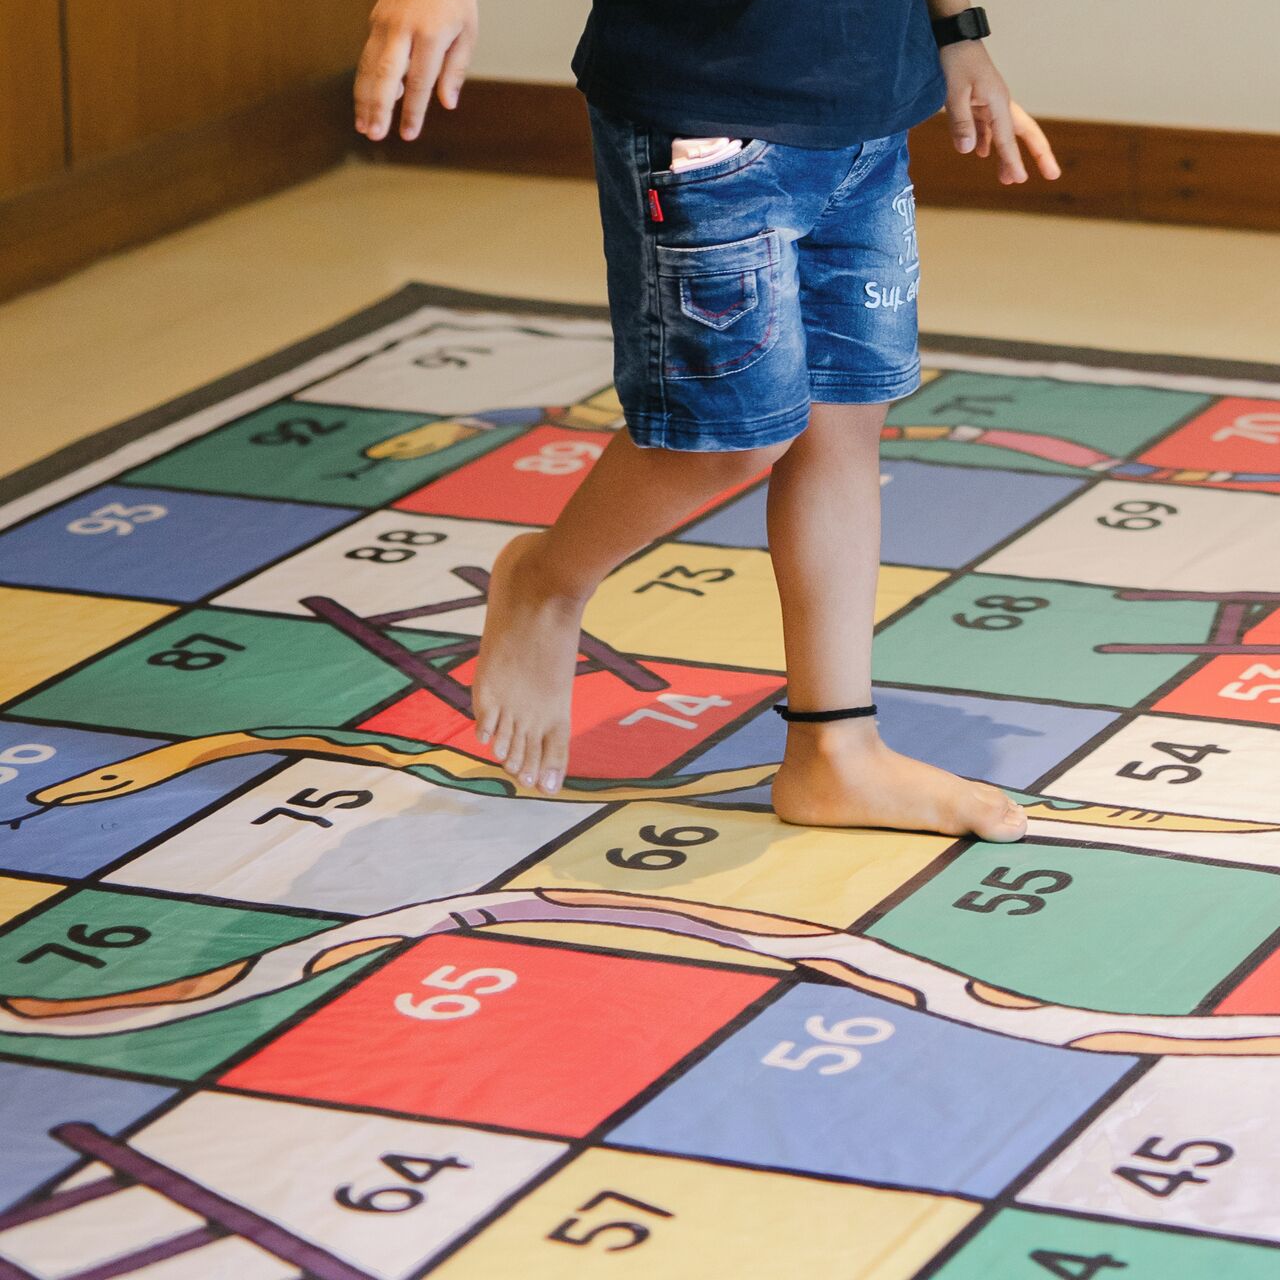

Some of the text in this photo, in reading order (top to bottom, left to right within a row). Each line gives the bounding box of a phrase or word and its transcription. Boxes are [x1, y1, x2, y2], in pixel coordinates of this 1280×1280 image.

[412, 345, 491, 369] 91
[249, 415, 348, 447] 92
[67, 502, 168, 536] 93
[1096, 499, 1178, 532] 69
[345, 529, 447, 564] 88
[634, 564, 735, 597] 73
[952, 595, 1051, 631] 68
[146, 633, 247, 671] 87
[618, 693, 731, 730] 74
[1115, 740, 1231, 785] 54
[250, 787, 374, 829] 75
[605, 824, 719, 871] 66
[951, 866, 1074, 917] 55
[17, 923, 151, 969] 76
[394, 964, 518, 1020] 65
[760, 1015, 895, 1076] 56
[333, 1153, 470, 1213] 64
[1112, 1135, 1235, 1200] 45
[544, 1190, 675, 1252] 57
